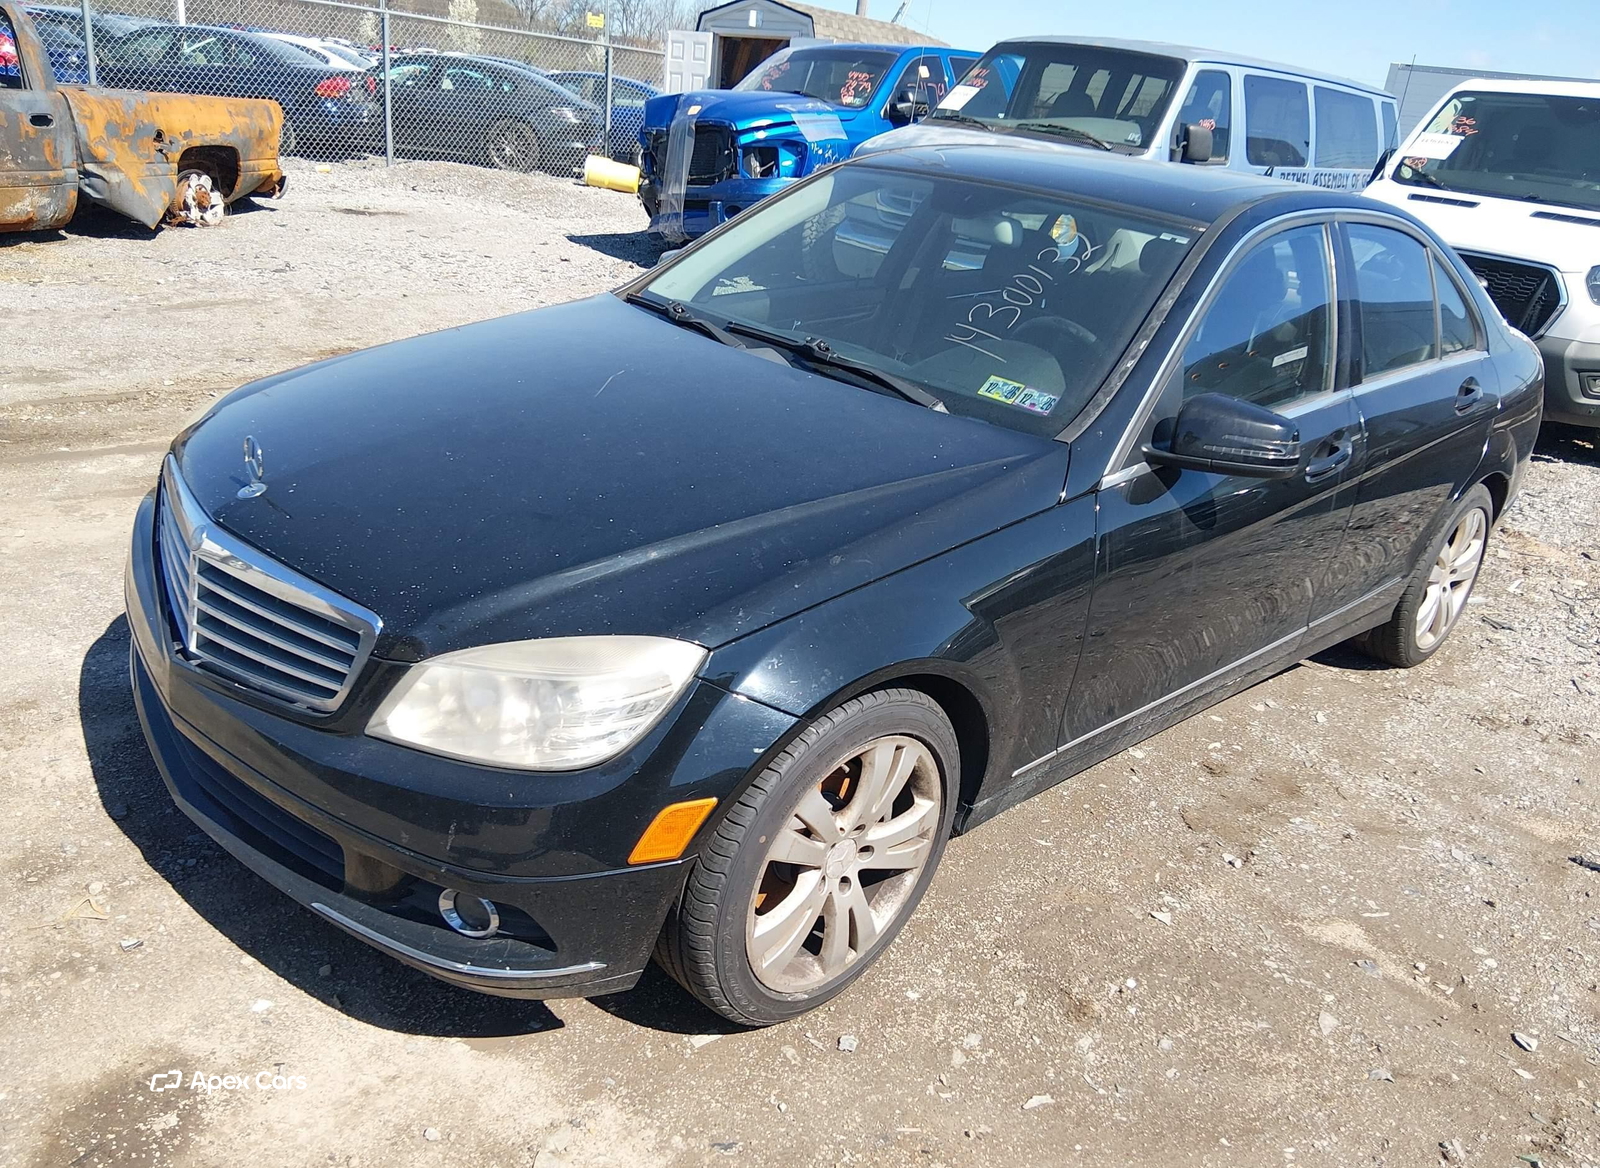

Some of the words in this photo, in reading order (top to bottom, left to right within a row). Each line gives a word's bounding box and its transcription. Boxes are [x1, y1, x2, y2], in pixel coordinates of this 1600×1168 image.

[1312, 172, 1350, 189] ASSEMBLY
[1351, 173, 1360, 189] OF
[985, 382, 999, 394] 12
[1019, 392, 1034, 405] 12
